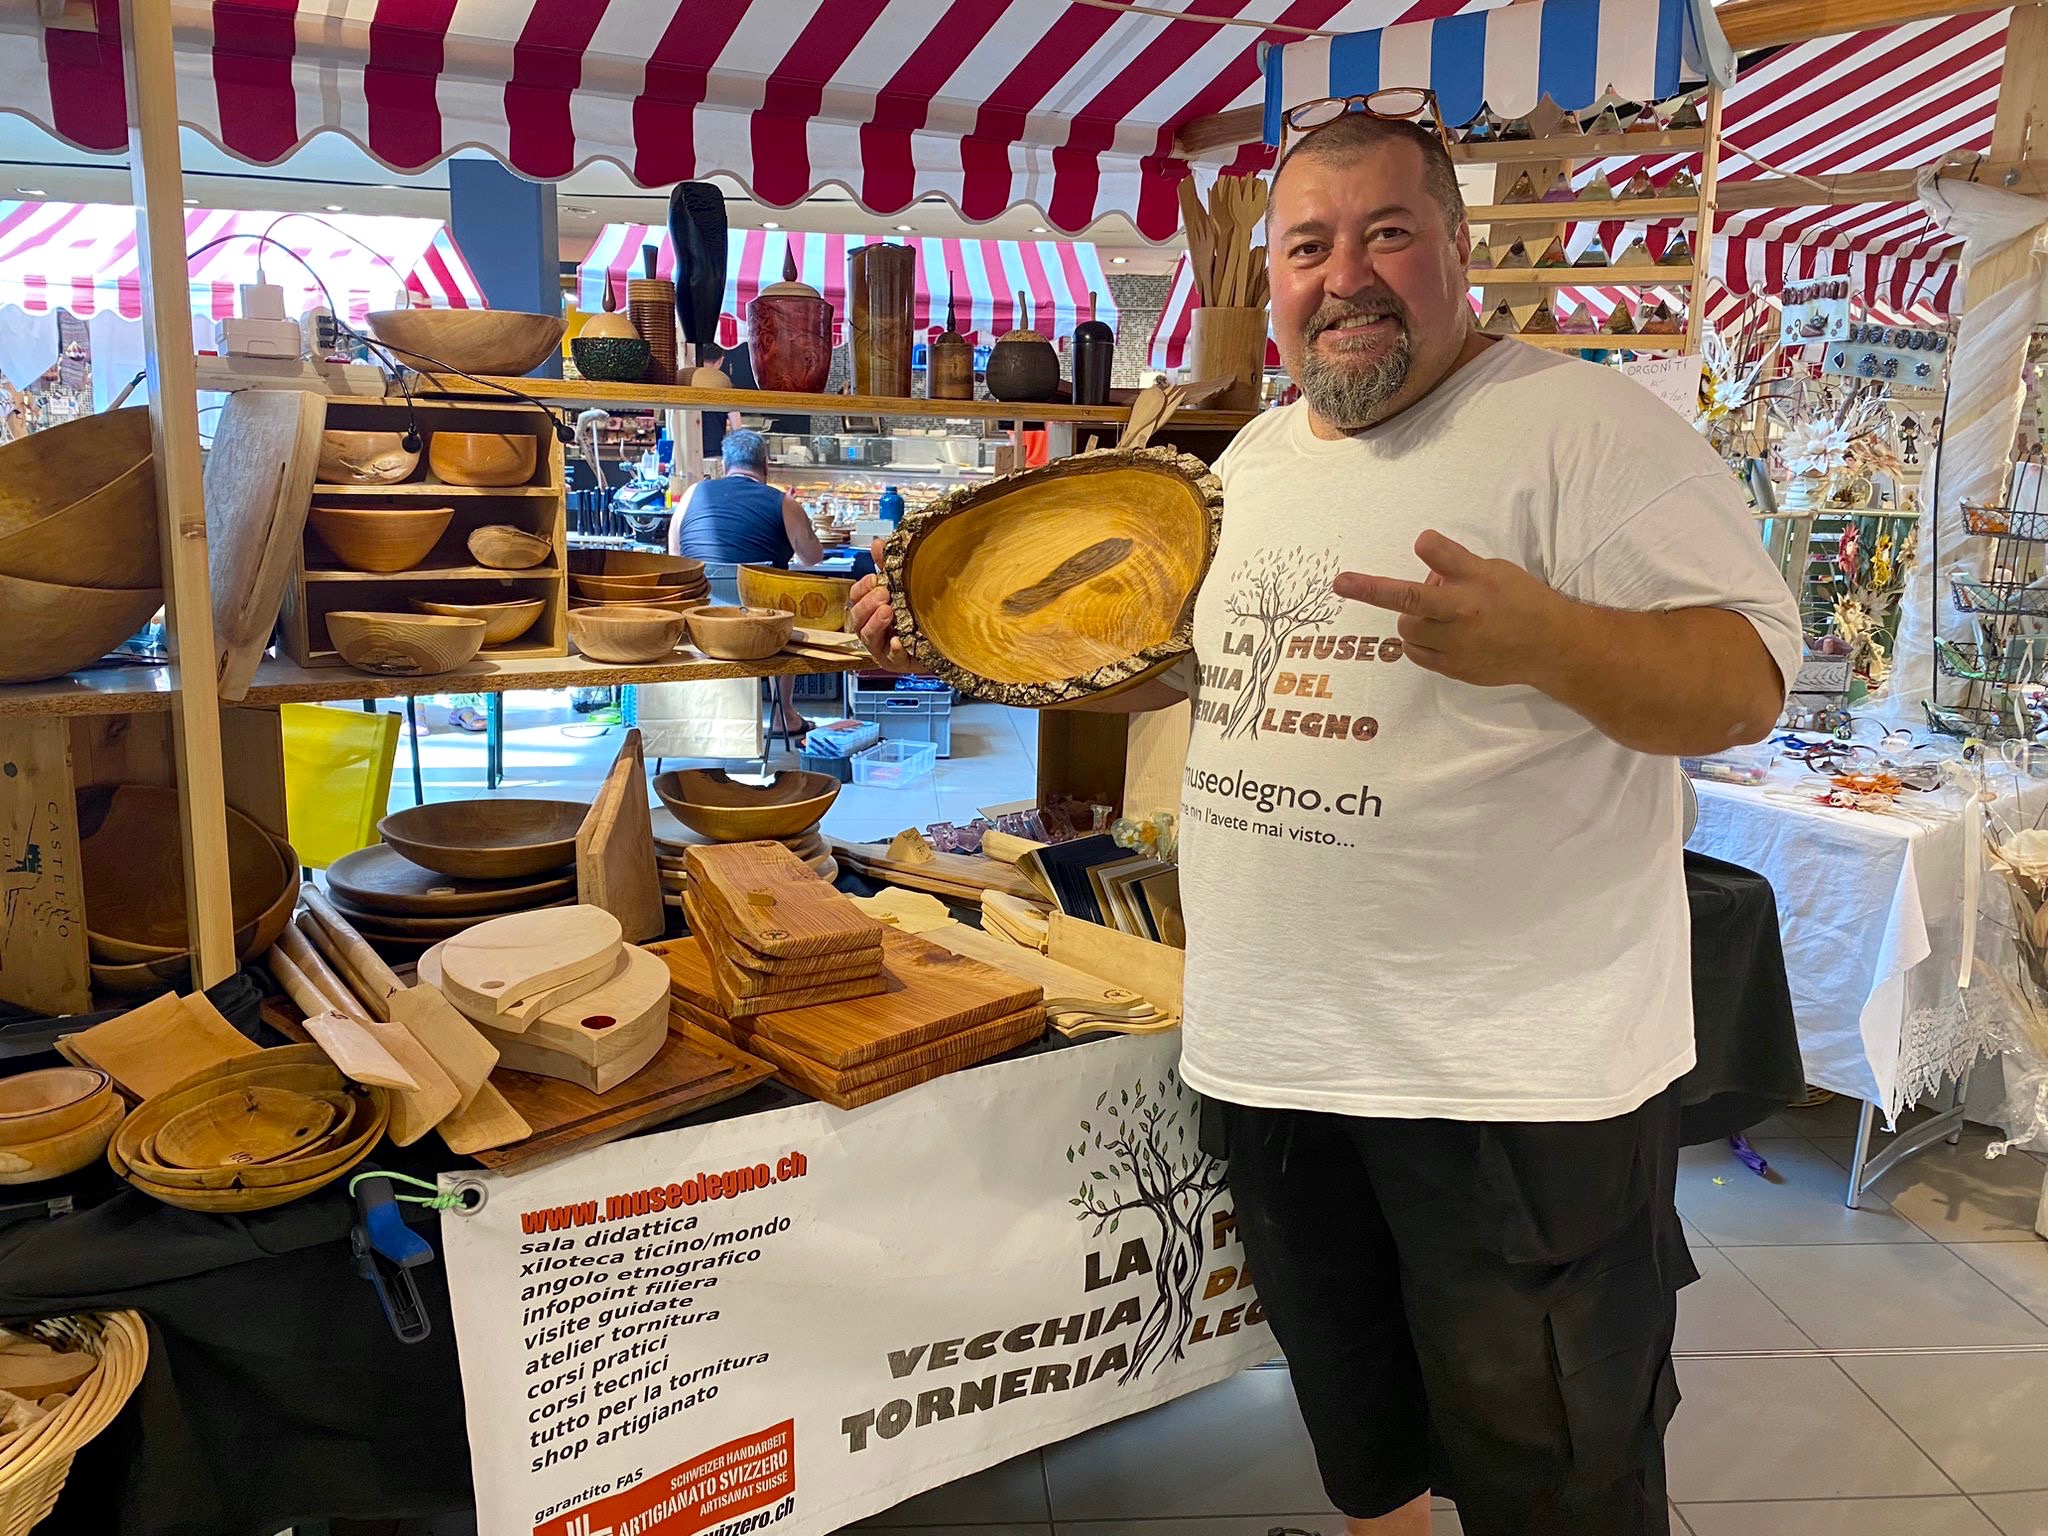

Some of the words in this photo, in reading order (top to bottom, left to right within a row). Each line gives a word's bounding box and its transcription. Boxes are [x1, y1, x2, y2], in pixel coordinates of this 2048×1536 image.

[1222, 632, 1254, 656] LA
[1285, 635, 1403, 663] MUSEO
[1273, 672, 1333, 699] DEL
[1261, 708, 1379, 741] LEGNO
[1205, 807, 1248, 831] l'avete
[1252, 822, 1283, 837] mai
[1289, 827, 1355, 848] visto...
[520, 1151, 807, 1235] www.museolegno.ch
[520, 1237, 575, 1254] sala
[585, 1216, 698, 1248] didattica
[520, 1253, 624, 1278] xiloteca
[634, 1216, 790, 1261] ticino/mondo
[521, 1271, 609, 1301] angolo
[617, 1249, 761, 1280] etnografico
[1085, 1237, 1152, 1293] LA
[523, 1285, 638, 1326] infopoint
[645, 1277, 718, 1295] filiera
[525, 1317, 590, 1350] visite
[598, 1297, 693, 1328] guidate
[526, 1334, 605, 1375] atelier
[612, 1311, 720, 1342] tornitura
[527, 1362, 585, 1399] corsi
[592, 1334, 668, 1379] pratici
[887, 1296, 1142, 1379] VECCHIA
[529, 1386, 586, 1423] corsi
[594, 1354, 669, 1397] tecnici
[530, 1414, 589, 1448] tutto
[597, 1395, 637, 1425] per
[644, 1385, 661, 1403] la
[670, 1353, 769, 1391] tornitura
[841, 1343, 1128, 1453] TORNERIA
[531, 1439, 588, 1473] shop
[596, 1386, 718, 1446] artigianato
[670, 1457, 725, 1491] SCHWEIZER
[726, 1431, 787, 1464] HANDARBEIT
[535, 1484, 611, 1524] garantito
[617, 1467, 643, 1489] FAS
[617, 1476, 717, 1536] ARTIGIANATO
[719, 1449, 788, 1491] SVIZZERO
[700, 1483, 756, 1517] ARTISANAT
[755, 1470, 788, 1497] SUISSE
